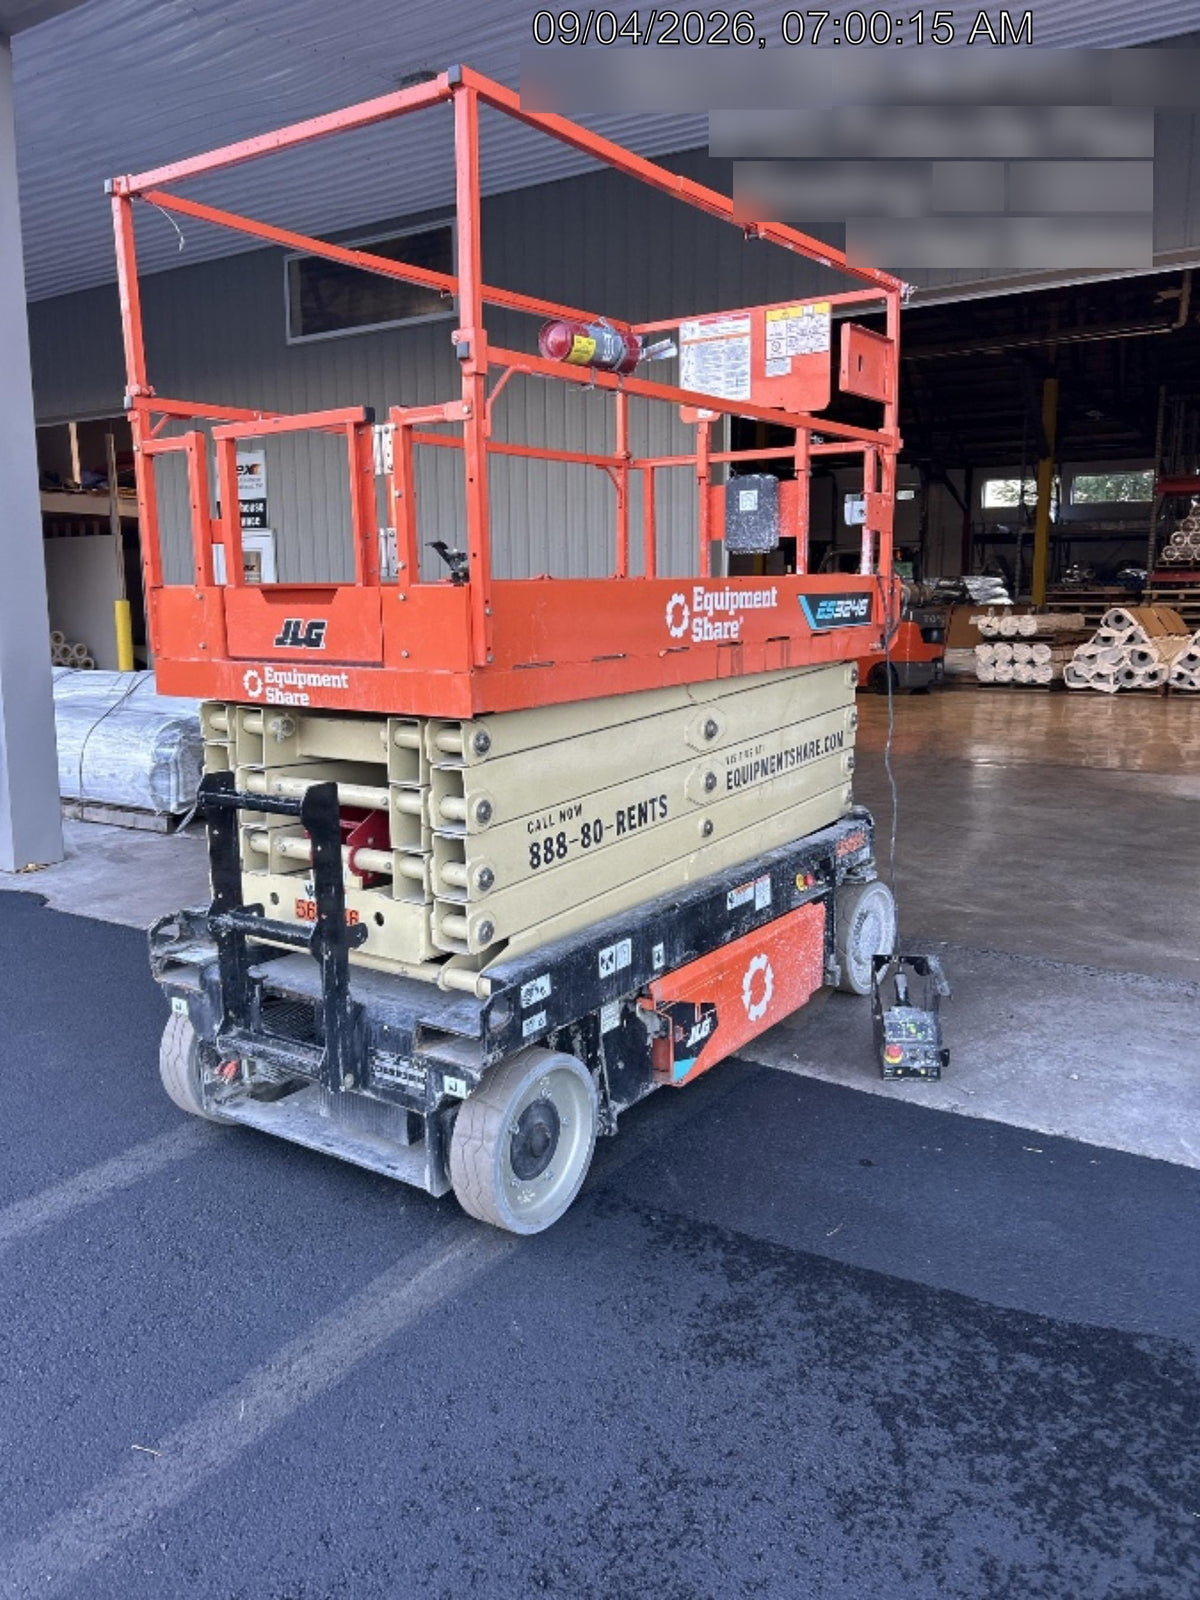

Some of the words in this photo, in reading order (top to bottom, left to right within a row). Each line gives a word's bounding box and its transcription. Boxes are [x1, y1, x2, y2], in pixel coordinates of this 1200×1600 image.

[693, 586, 778, 616] Equipment
[816, 599, 869, 619] ES3246
[275, 619, 327, 648] JLG
[692, 616, 740, 642] Share
[264, 666, 349, 689] Equipment
[265, 687, 310, 706] Share
[527, 814, 555, 834] CALL
[559, 803, 582, 823] NOW
[529, 794, 668, 869] 888-80-RENTS
